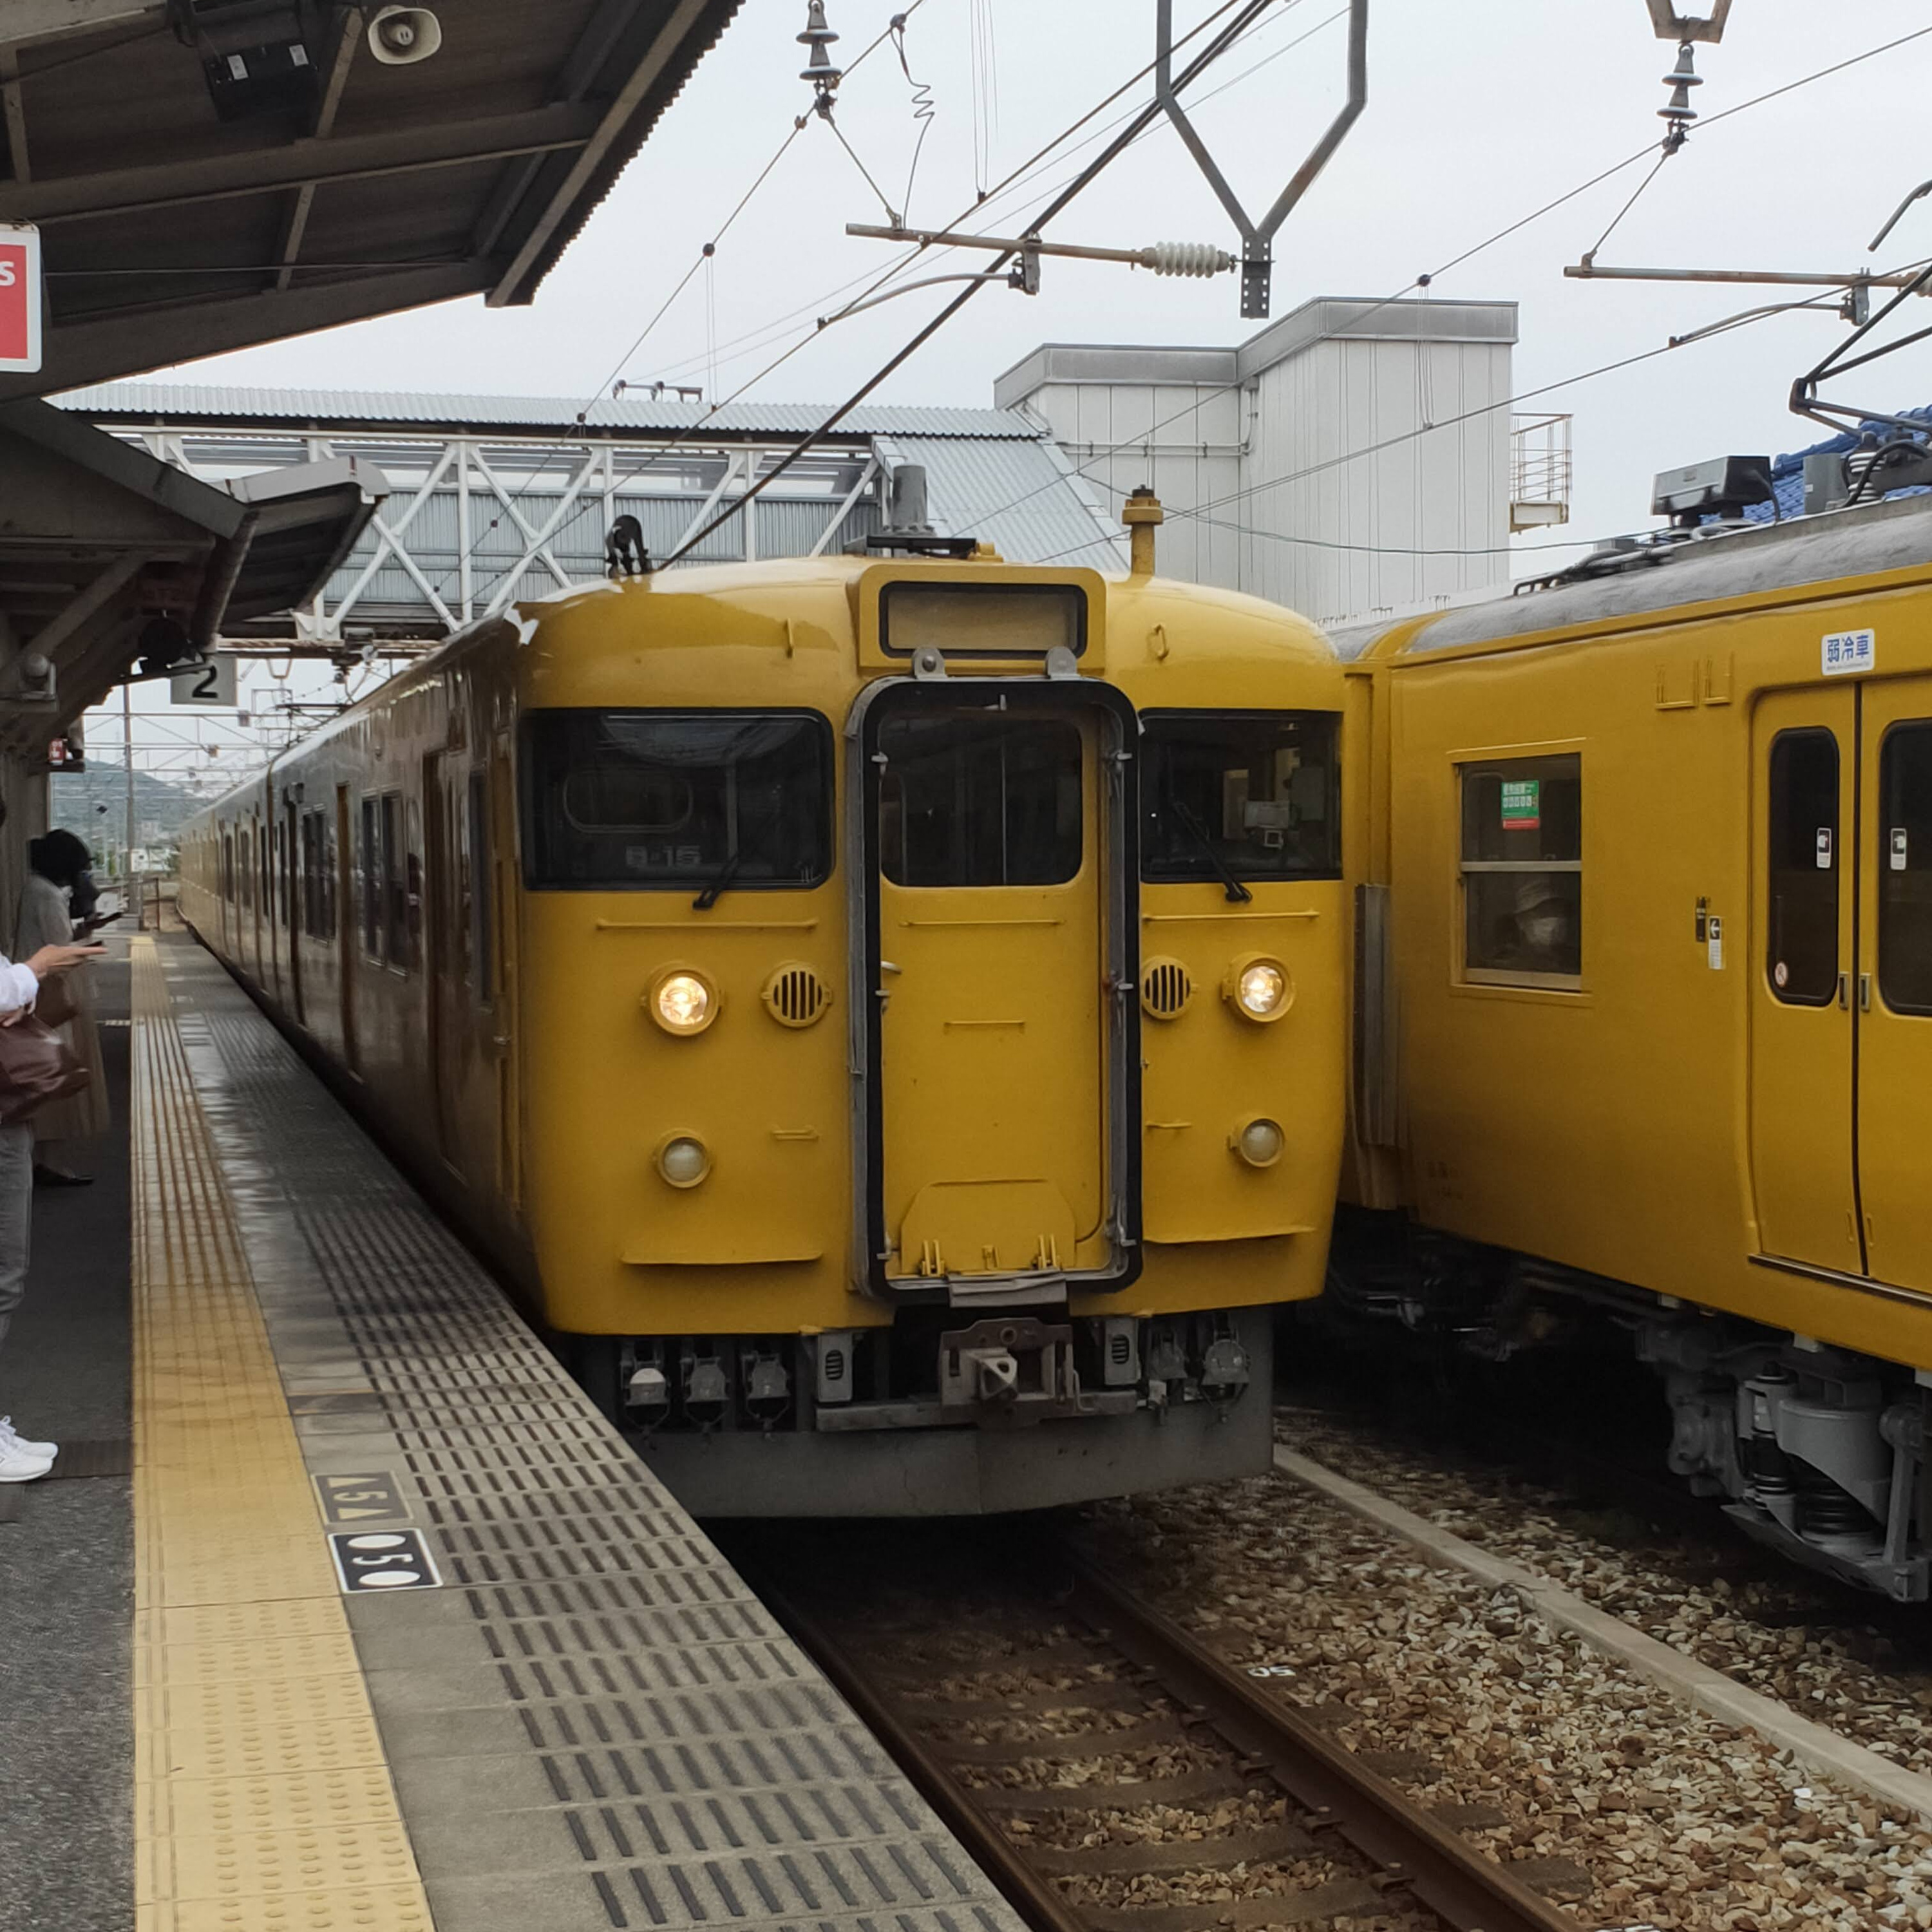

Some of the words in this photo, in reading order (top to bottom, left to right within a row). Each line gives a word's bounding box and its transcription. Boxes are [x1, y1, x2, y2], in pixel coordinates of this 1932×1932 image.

[1827, 634, 1869, 663] 弱冷車
[192, 665, 218, 698] 2
